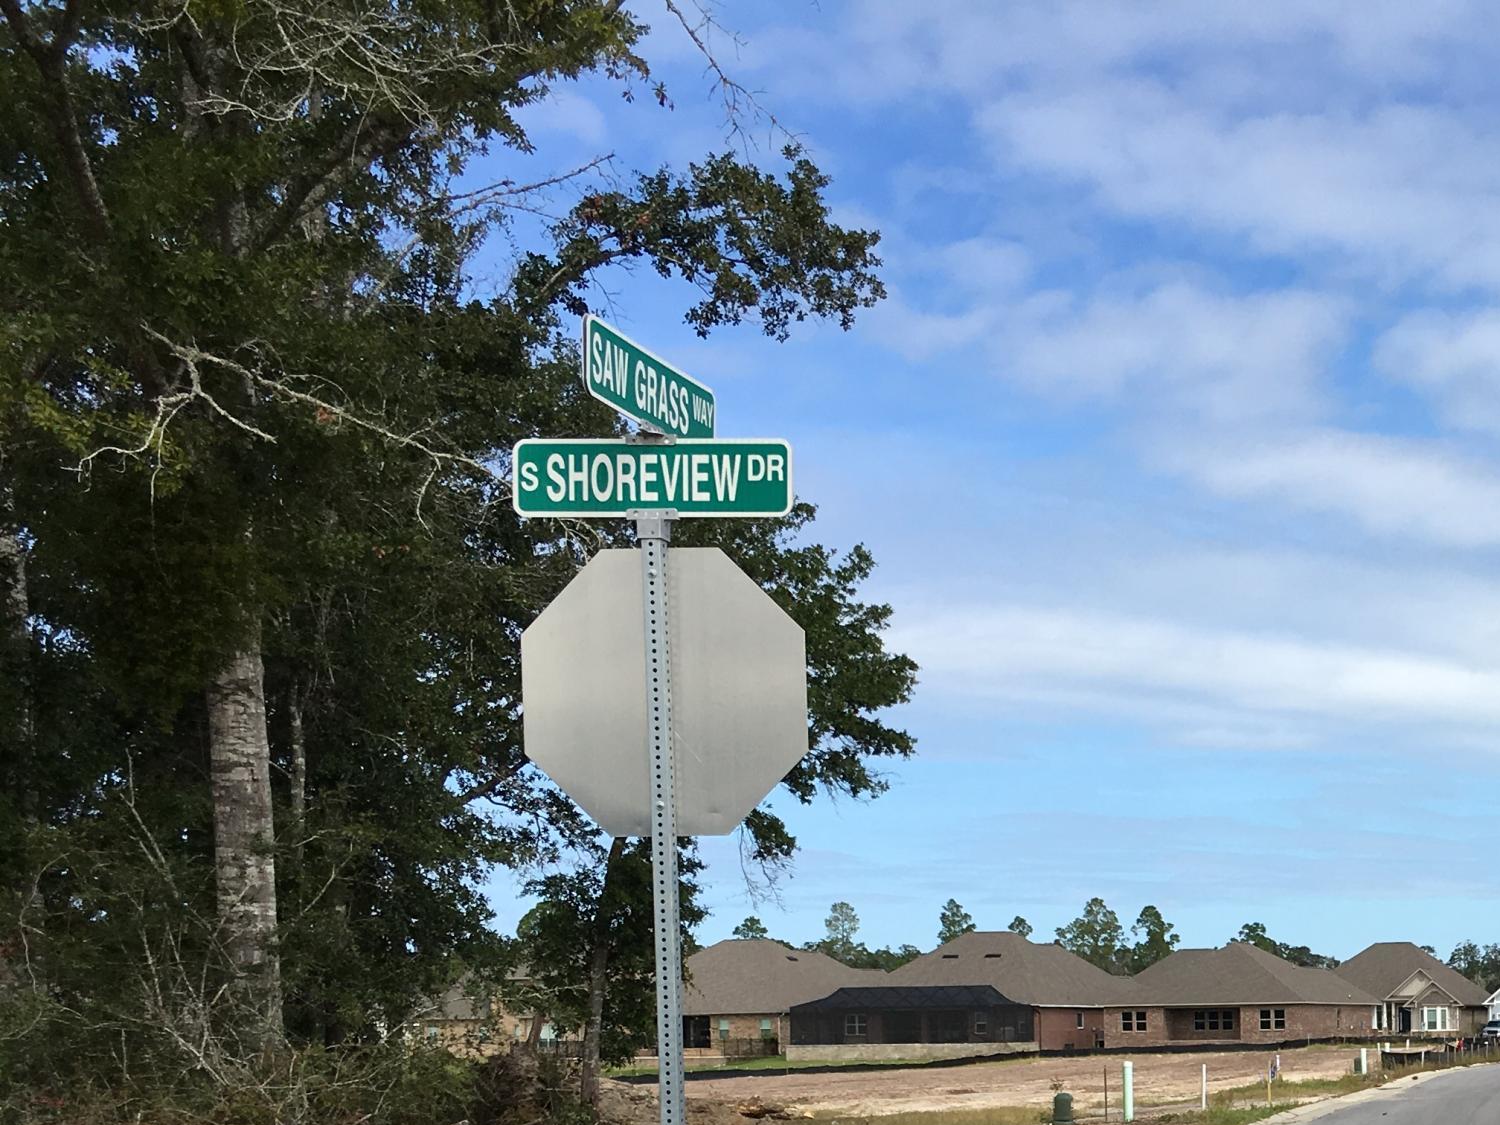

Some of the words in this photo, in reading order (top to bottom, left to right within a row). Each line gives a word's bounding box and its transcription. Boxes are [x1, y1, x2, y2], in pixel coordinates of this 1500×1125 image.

[592, 332, 628, 398] SAW
[634, 360, 689, 435] GRASS
[692, 393, 713, 429] WAY
[521, 462, 539, 492] S
[546, 453, 741, 502] SHOREVIEW
[747, 455, 784, 481] DR
